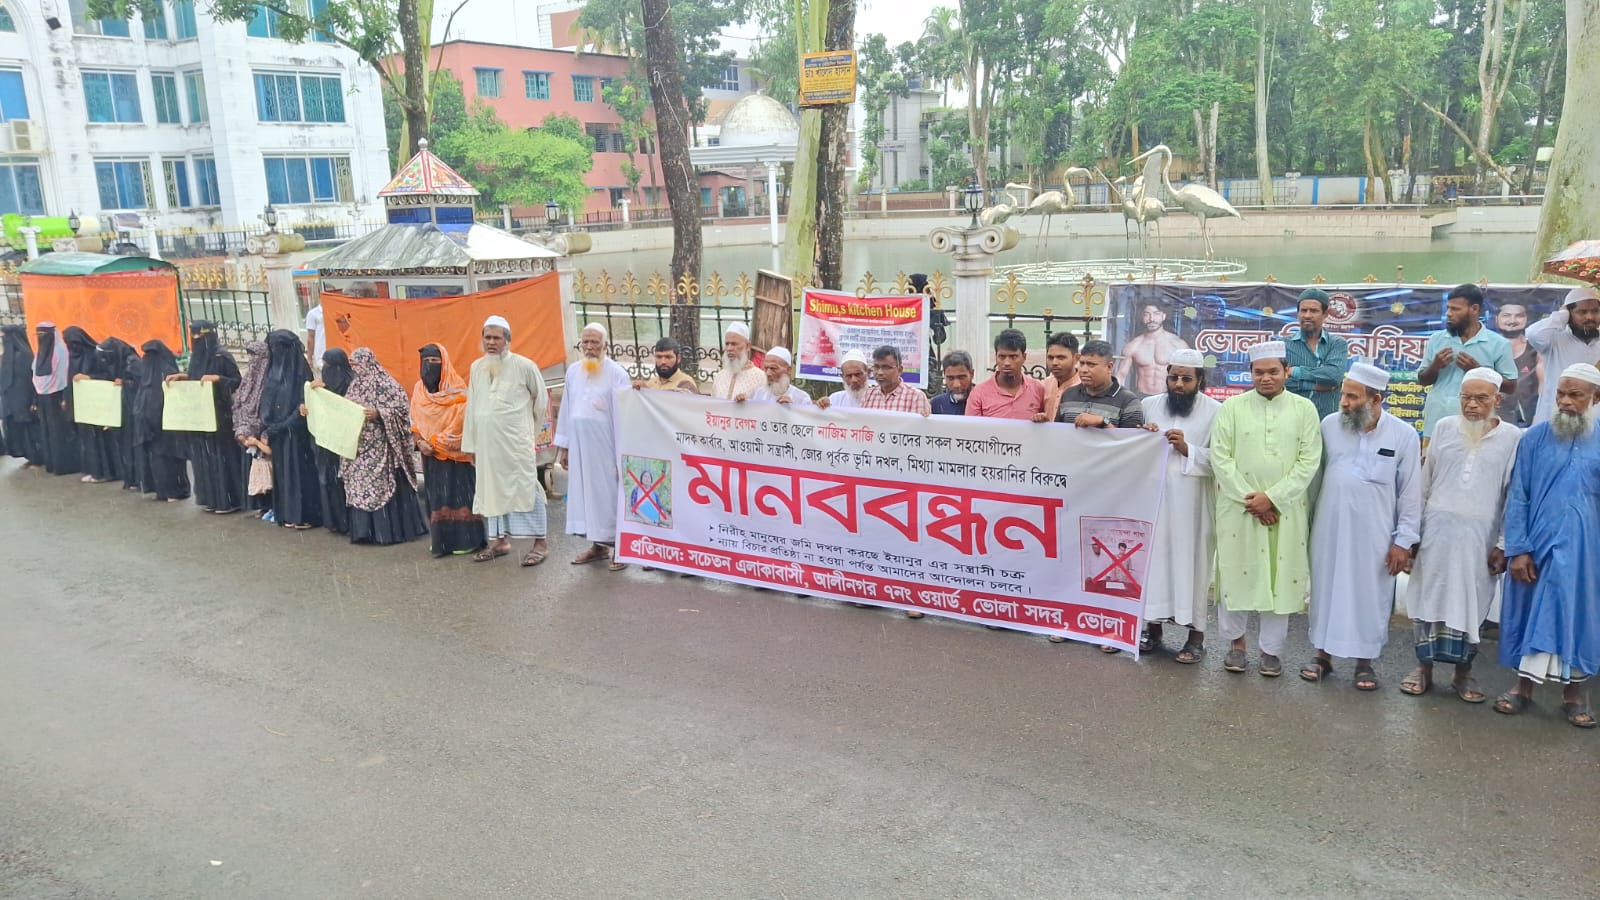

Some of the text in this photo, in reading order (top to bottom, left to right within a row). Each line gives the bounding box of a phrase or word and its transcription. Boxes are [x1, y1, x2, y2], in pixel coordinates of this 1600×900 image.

[809, 299, 917, 318] Shimu,s kitchen House
[675, 431, 697, 446] মাদক
[728, 437, 764, 456] আওয়ামী
[802, 447, 822, 461] জোর
[826, 448, 850, 468] পূর্বক
[853, 450, 872, 470] ভূমি
[876, 455, 903, 473] দখল,
[907, 454, 933, 475] মিথ্যা
[938, 461, 976, 479] মামলার
[981, 463, 1026, 484] হয়রানির
[1031, 466, 1067, 488] বিরুদ্ধে
[705, 411, 1022, 457] ইয়ানুর বেগম ও তার ছেলে নাজিম সাজি ও তাদের সকল সহযোগীদের
[680, 453, 1063, 559] মানববন্ধন
[718, 524, 747, 538] নিরীহ
[750, 530, 786, 545] মানুষের
[791, 535, 812, 550] জমি
[816, 542, 842, 555] দখল
[845, 547, 879, 561] করছে
[884, 550, 922, 568] ইয়ানুর
[928, 558, 947, 570] এর
[1000, 569, 1026, 581] চক্র
[718, 538, 738, 549] ন্যায়
[743, 539, 766, 553] বিচার
[770, 546, 800, 560] প্রতিষ্ঠা
[804, 552, 814, 562] না
[819, 554, 844, 568] হওয়া
[848, 557, 874, 573] পর্যন্ত
[878, 565, 925, 580] আমাদের
[929, 572, 984, 589] আন্দোলন
[990, 581, 1022, 593] চলবে
[630, 536, 684, 562] প্রতিবাদে:
[688, 550, 732, 572] সচেতন
[736, 558, 809, 588] এলাকাবাসী,
[812, 567, 877, 597] আলীনগর
[884, 585, 914, 604] ৭নং
[917, 588, 966, 614] ওয়ার্ড,
[973, 597, 1019, 619] ভোলা
[1025, 604, 1070, 630] সদর,
